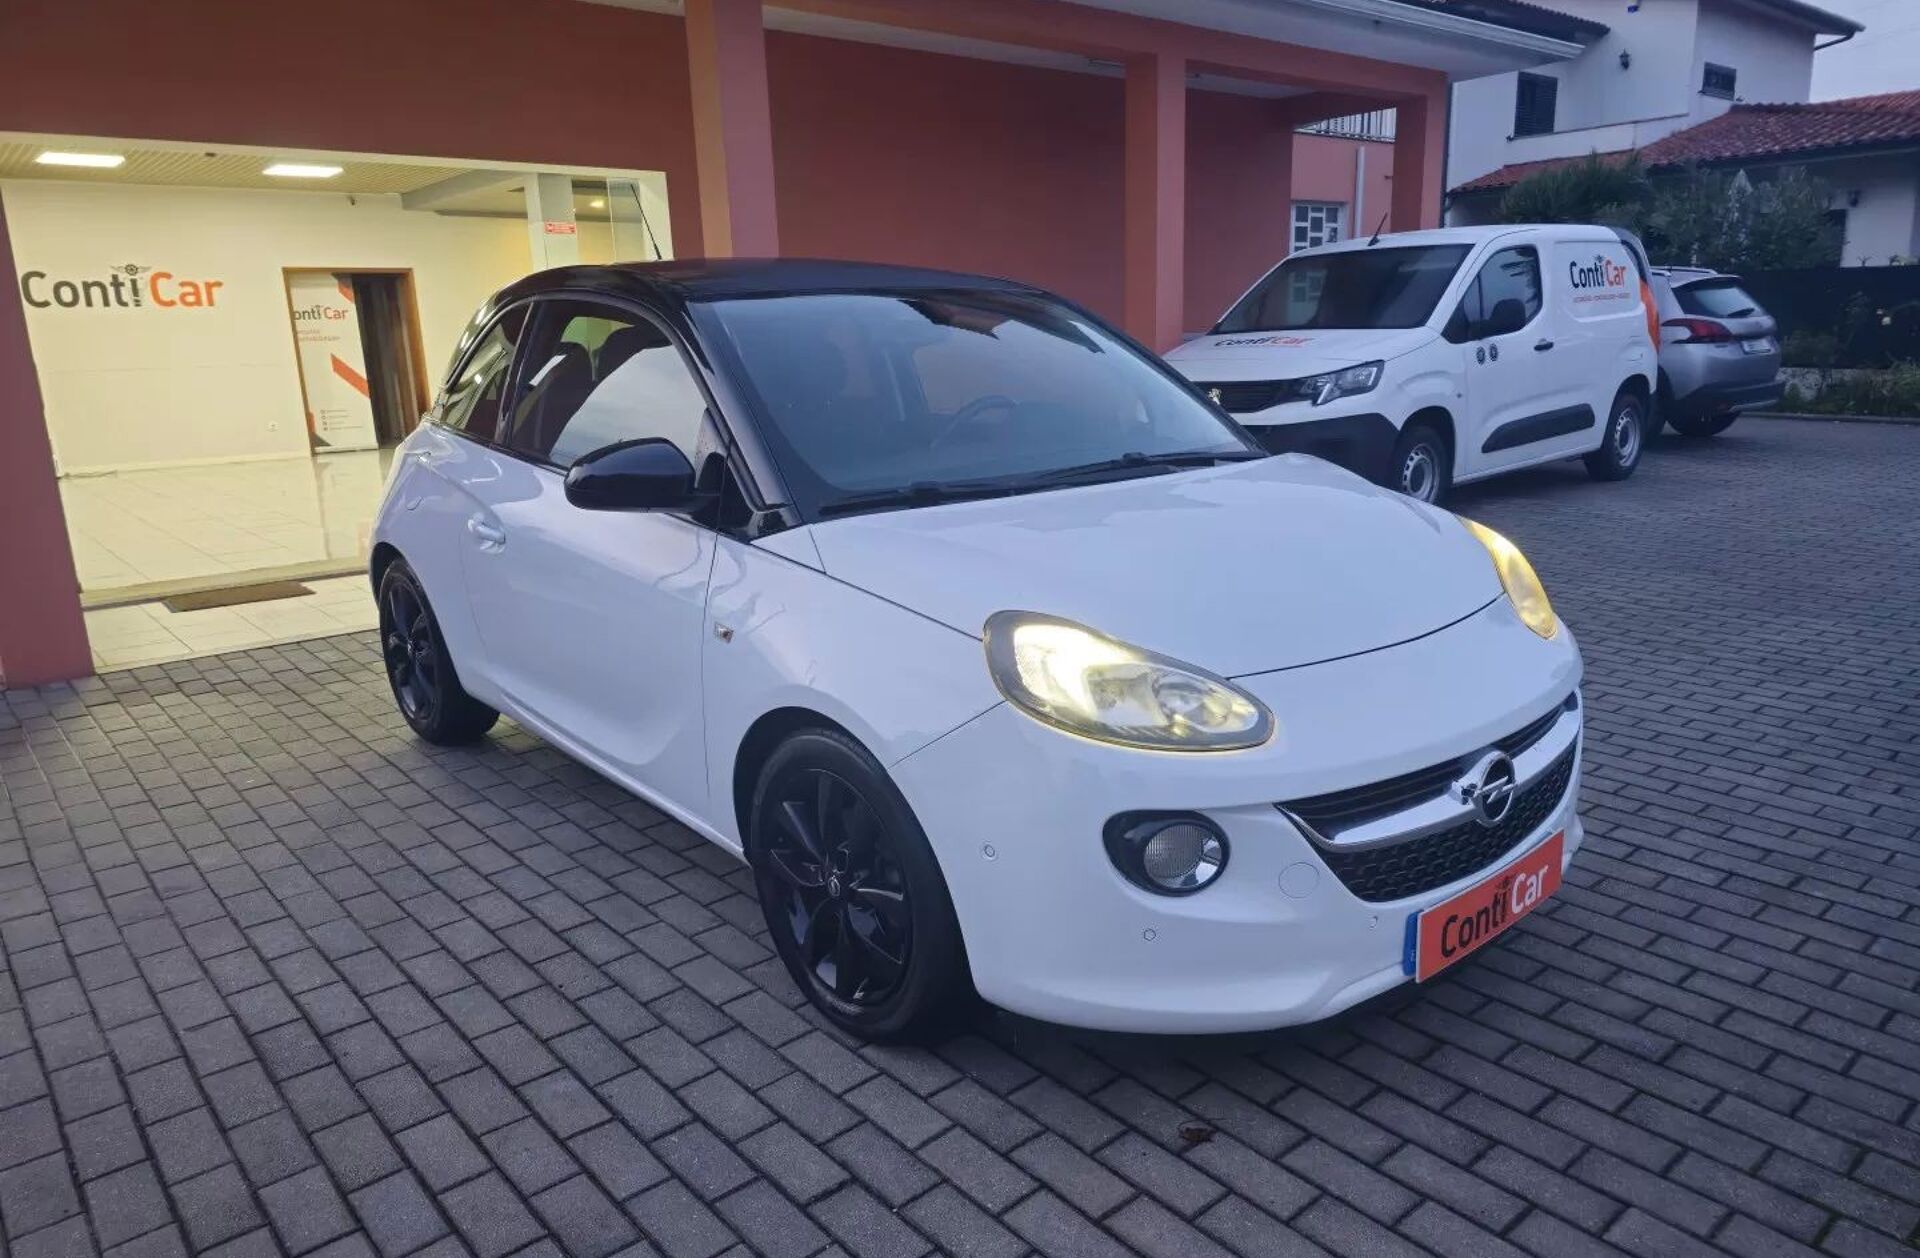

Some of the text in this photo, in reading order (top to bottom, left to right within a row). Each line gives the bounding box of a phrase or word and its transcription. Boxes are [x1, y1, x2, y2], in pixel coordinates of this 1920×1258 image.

[20, 269, 224, 309] Conti Car
[1570, 259, 1627, 289] Conti Car
[292, 306, 348, 321] onti Car
[1441, 865, 1549, 958] Conti Car
